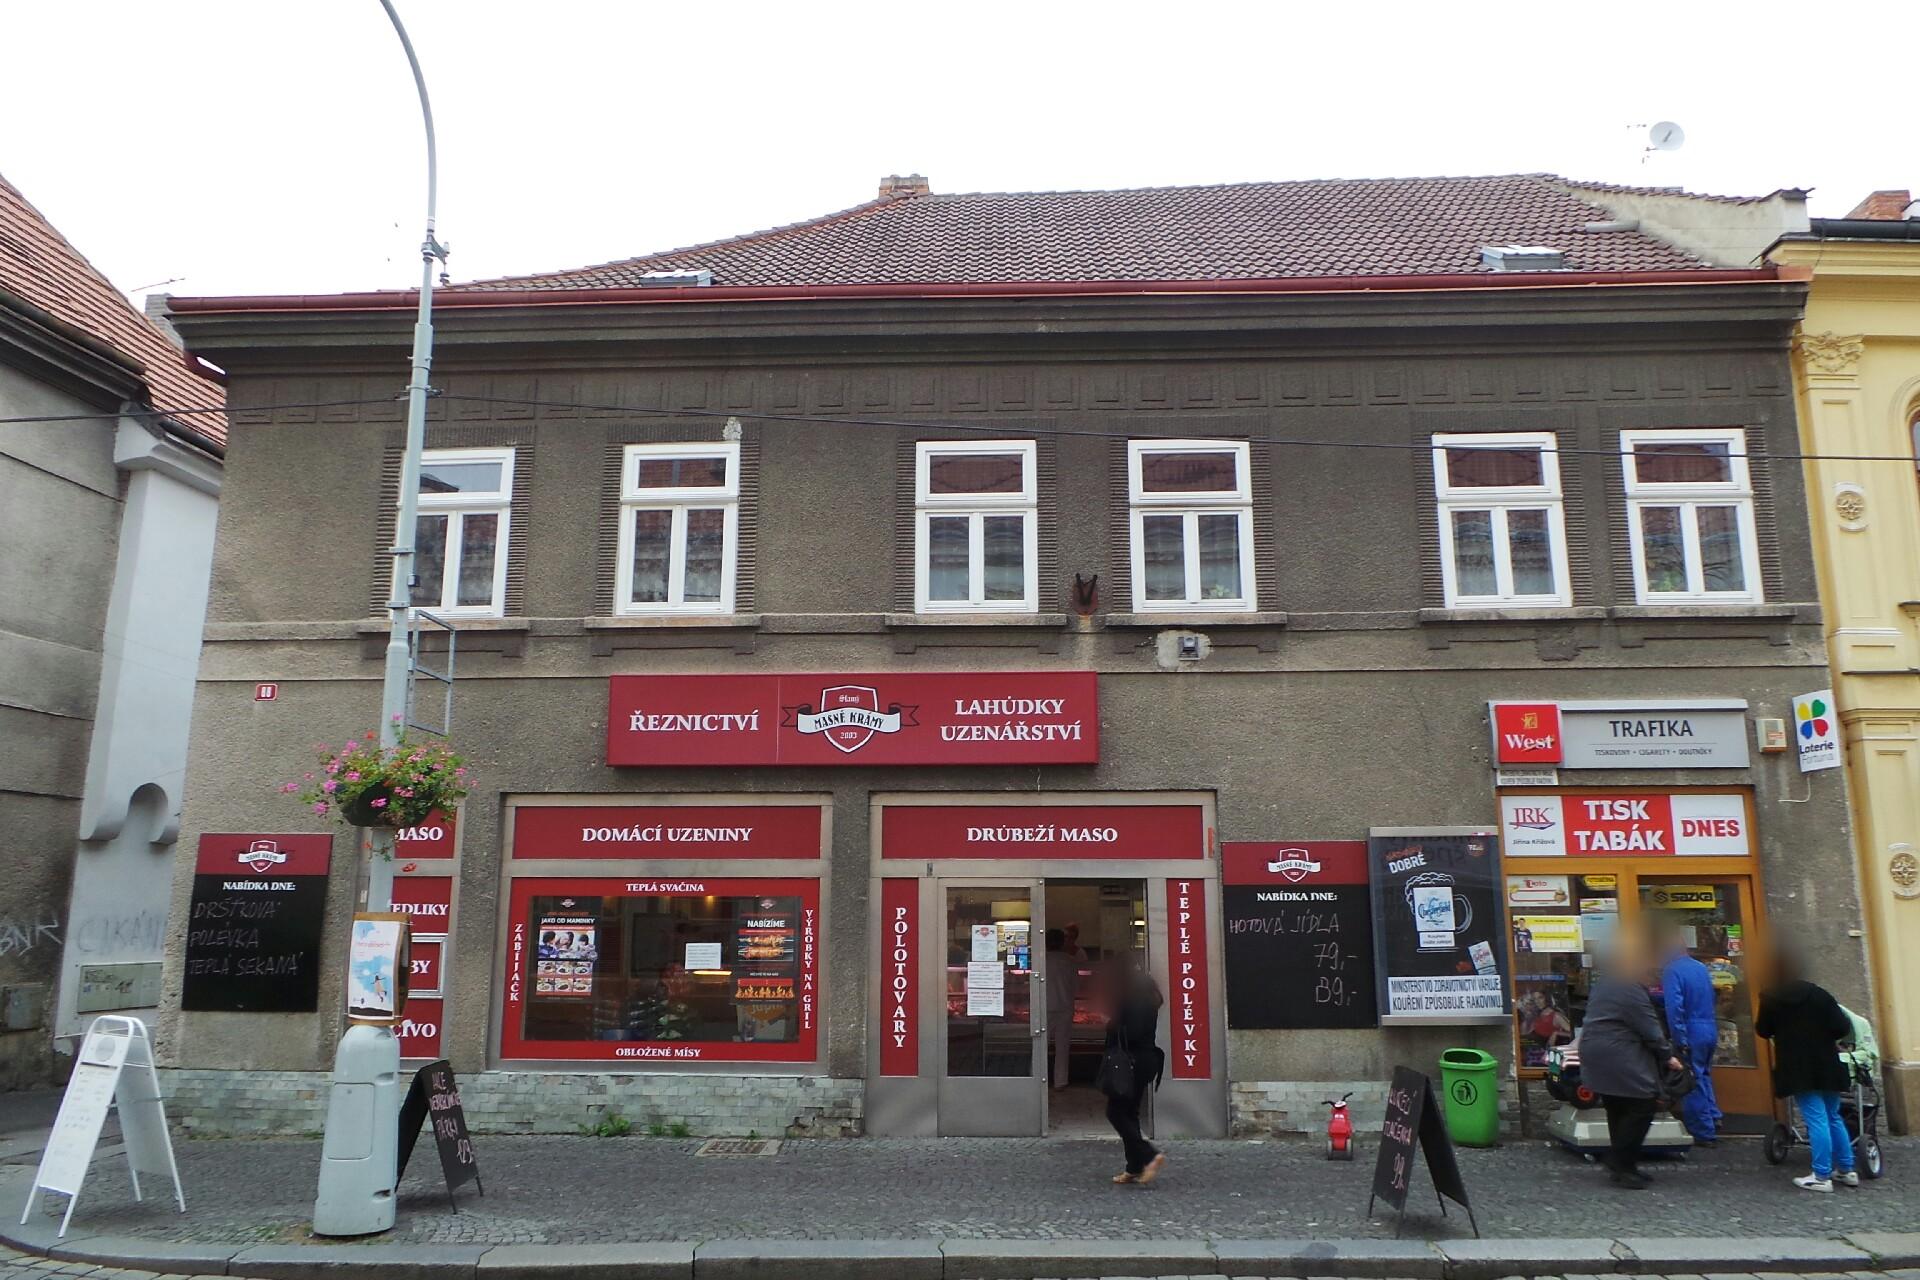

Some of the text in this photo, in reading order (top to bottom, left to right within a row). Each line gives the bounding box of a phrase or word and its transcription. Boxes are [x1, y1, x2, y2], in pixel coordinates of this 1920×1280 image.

[954, 694, 1066, 716] LAHŮDKY
[629, 709, 760, 732] ŘEZNICTVÍ
[814, 709, 885, 730] MASNÉ KRÁMY
[1609, 719, 1694, 738] TRAFIKA
[940, 719, 1082, 742] UZENÁŘSTVÍ
[1504, 733, 1554, 751] West
[1800, 740, 1834, 755] Loterie
[1583, 799, 1651, 821] TISK
[581, 823, 753, 842] DOMÁCÍ UZENINY
[966, 823, 1119, 843] DRŮBEŽÍ MASO
[1680, 819, 1740, 837] DNES
[1573, 824, 1666, 852] TABÁK
[1388, 851, 1427, 874] DOBRÉ
[222, 879, 297, 891] NABÍDKA DNE:
[625, 880, 705, 893] TEPLÁ SVAČINA
[1256, 890, 1338, 902] NABÍDKA DNE:
[540, 917, 596, 925] JAKO OD MAMINKY
[746, 918, 786, 929] NABÍZÍME
[1229, 908, 1340, 935] HOTOVÁ JÍDLA
[509, 923, 524, 1008] ZABÍJAČK
[802, 909, 814, 1030] VÝROBKY NA GRIL
[1178, 881, 1197, 1068] TEPLÉ POLÉVKY
[892, 906, 908, 1049] POLOTOVARY
[1391, 979, 1433, 993] MINISTERSTVO
[1392, 995, 1423, 1011] KOUŘENÍ
[1424, 993, 1465, 1010] ZPŮSOBUJE
[615, 1045, 701, 1058] OBLOŽENÉ MÍSY
